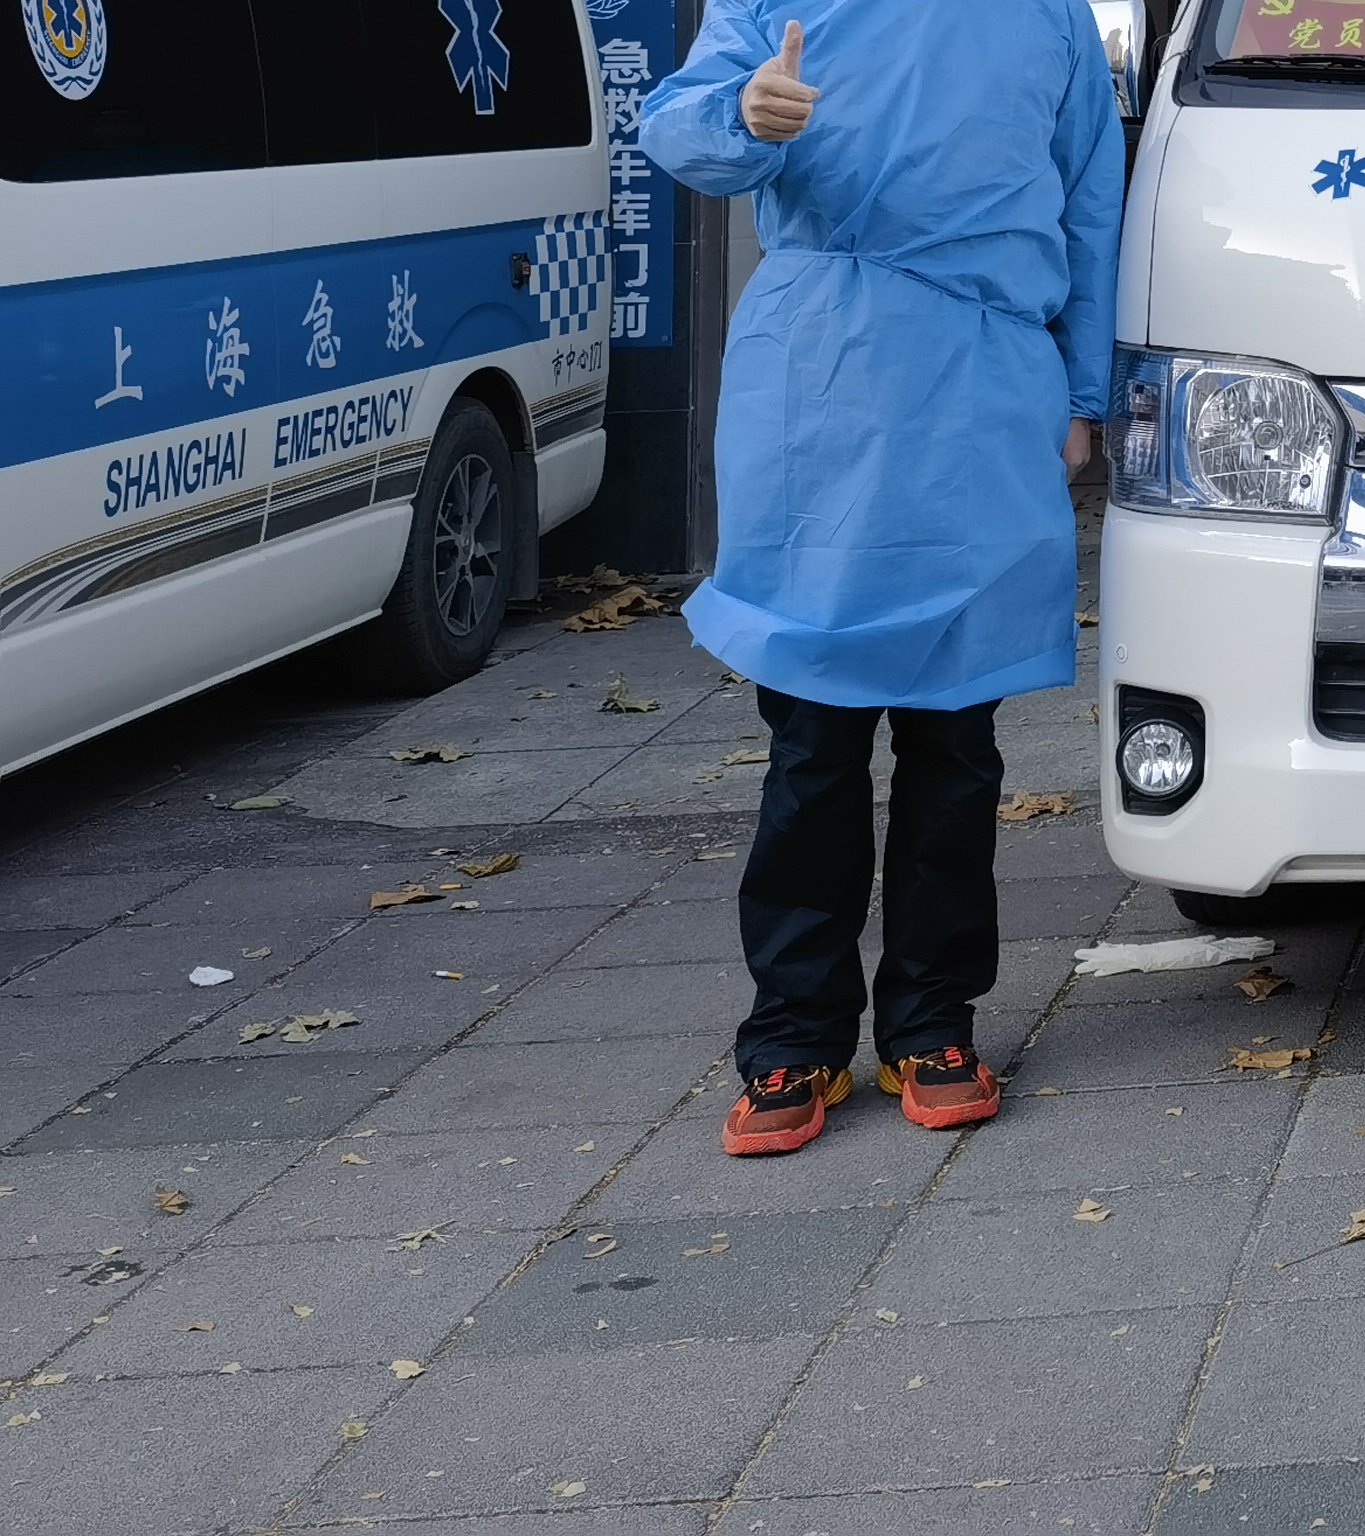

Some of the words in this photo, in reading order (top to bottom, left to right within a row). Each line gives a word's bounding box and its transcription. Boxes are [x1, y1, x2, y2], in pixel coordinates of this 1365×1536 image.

[95, 270, 424, 409] 上海急救
[103, 428, 247, 518] SHANGHAI
[273, 386, 413, 468] EMERGENCY
